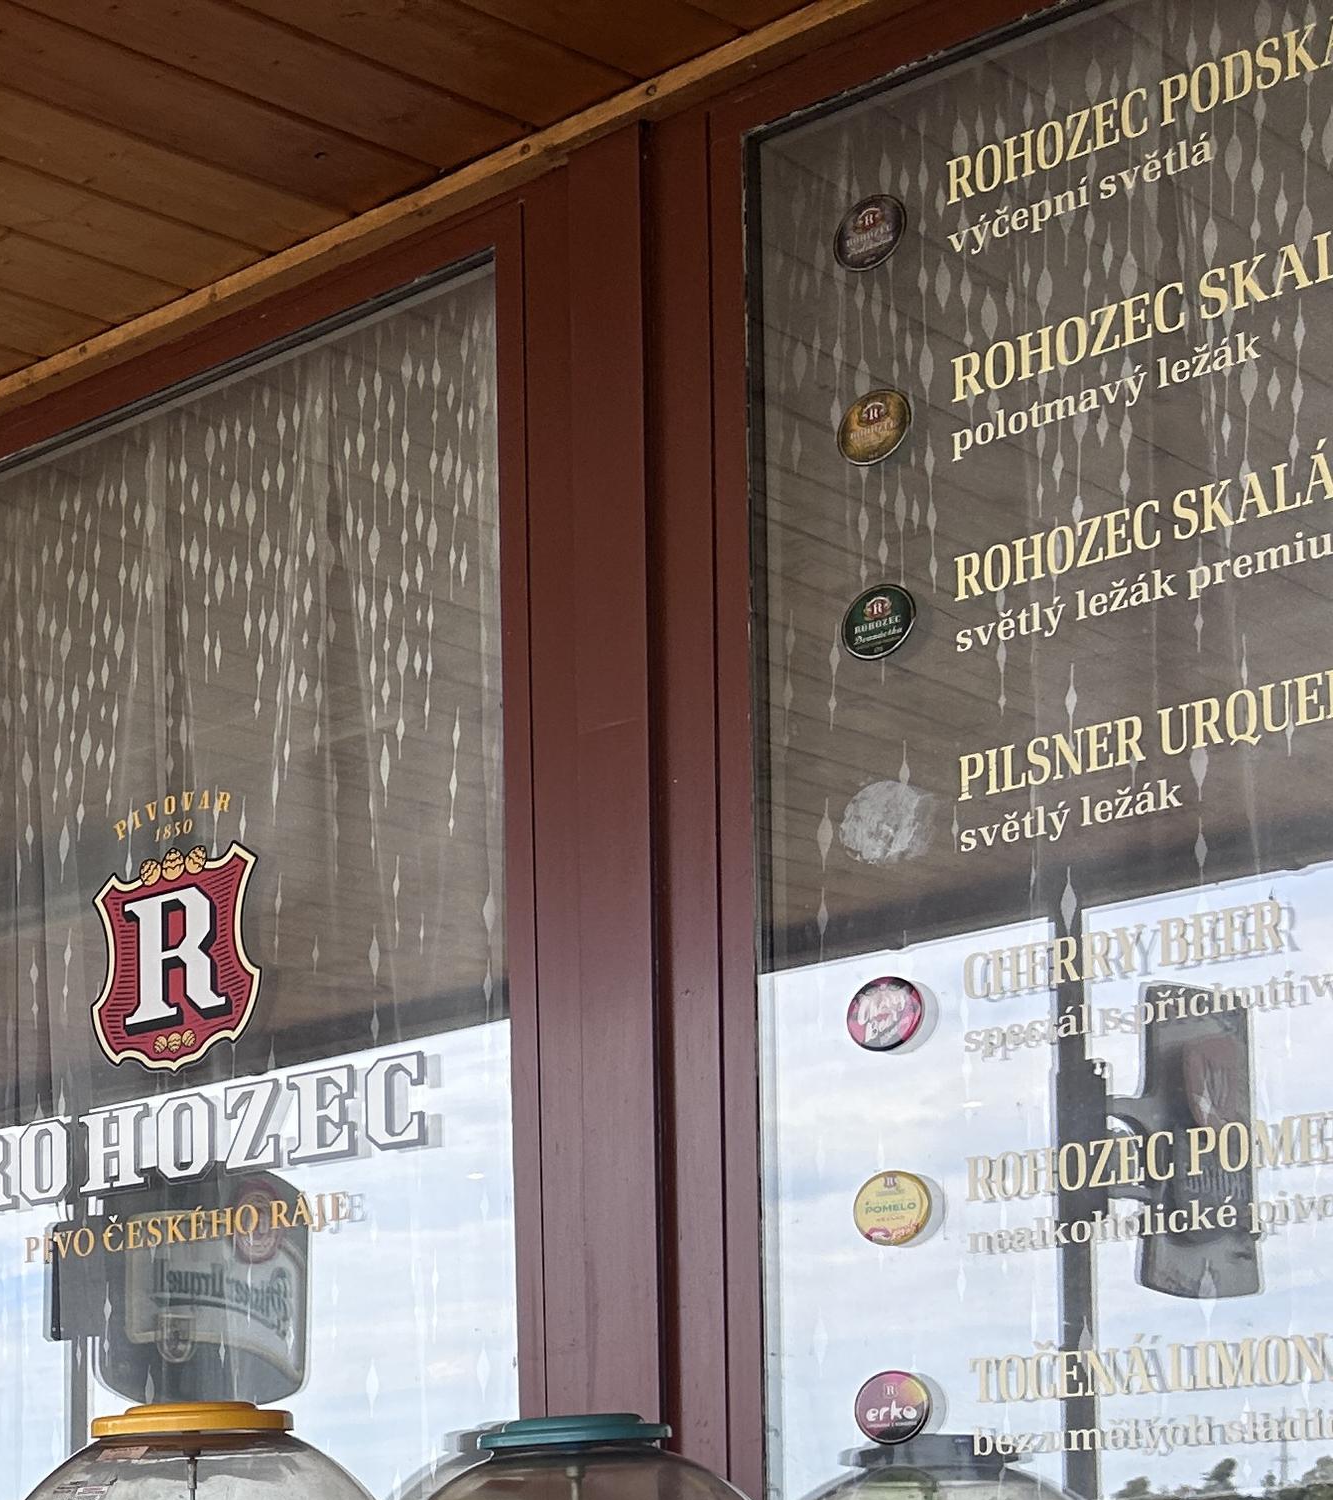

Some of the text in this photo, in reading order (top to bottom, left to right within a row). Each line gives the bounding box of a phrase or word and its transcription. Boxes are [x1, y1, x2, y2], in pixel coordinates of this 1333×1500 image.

[946, 89, 1149, 206] ROHOZEC
[947, 133, 1215, 256] výčepní světlá
[951, 281, 1185, 403] ROHOZEC
[952, 331, 1261, 462] polotmavý ležák
[953, 500, 1162, 602] ROHOZEC
[854, 614, 901, 634] ROHOZEC
[956, 596, 1068, 653] světlý
[1075, 569, 1177, 622] ležák
[958, 669, 1333, 802] PILSNER URQUE
[114, 789, 232, 842] PIVOVAR
[154, 817, 194, 843] 1850
[959, 779, 1183, 853] světlý ležák
[123, 886, 230, 1034] R
[964, 901, 1286, 1001] CHERRY BEER
[964, 1130, 1175, 1202] ROHOZEC
[25, 1191, 351, 1264] PIVO ČESKÉHO RÁJE
[864, 1201, 917, 1215] POMELO
[967, 1195, 1238, 1253] nealkoholické
[970, 1332, 1157, 1403] TOČENÁ
[865, 1400, 918, 1421] erko
